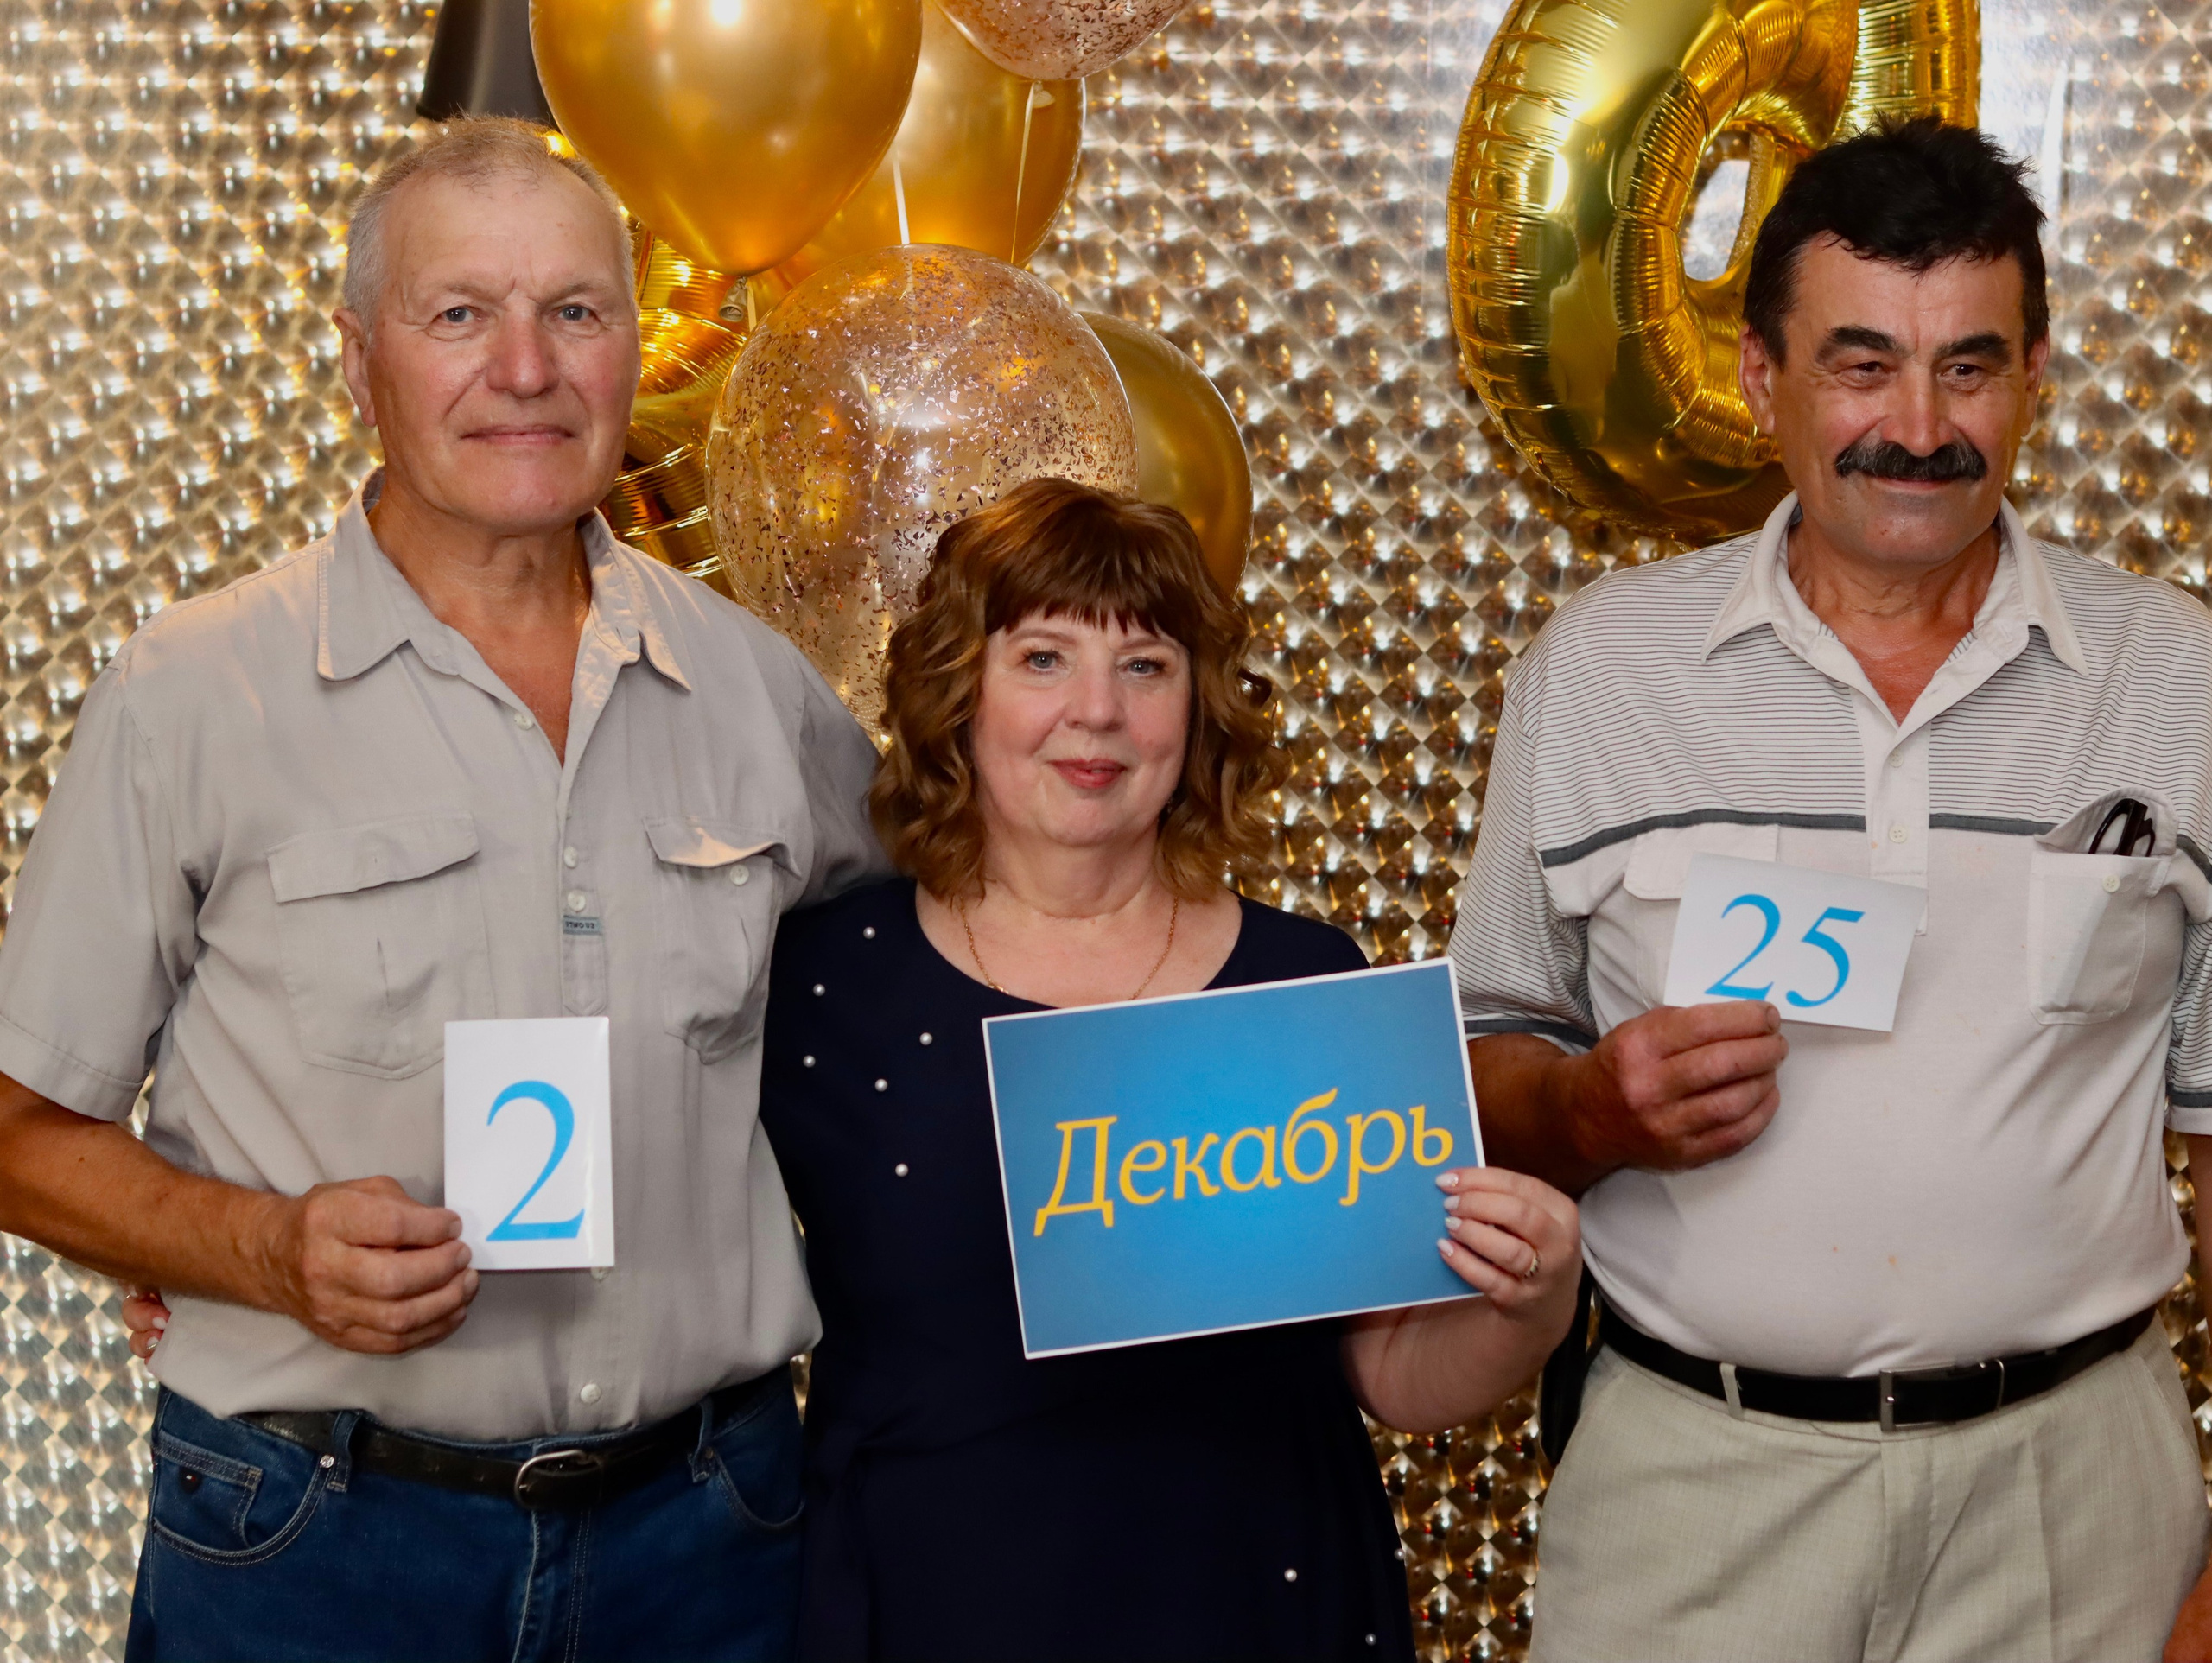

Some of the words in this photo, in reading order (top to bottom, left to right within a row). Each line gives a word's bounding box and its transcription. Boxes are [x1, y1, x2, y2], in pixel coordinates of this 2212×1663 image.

[1704, 892, 1866, 1008] 25
[486, 1080, 585, 1242] 2
[1033, 1088, 1454, 1237] Декабрь
